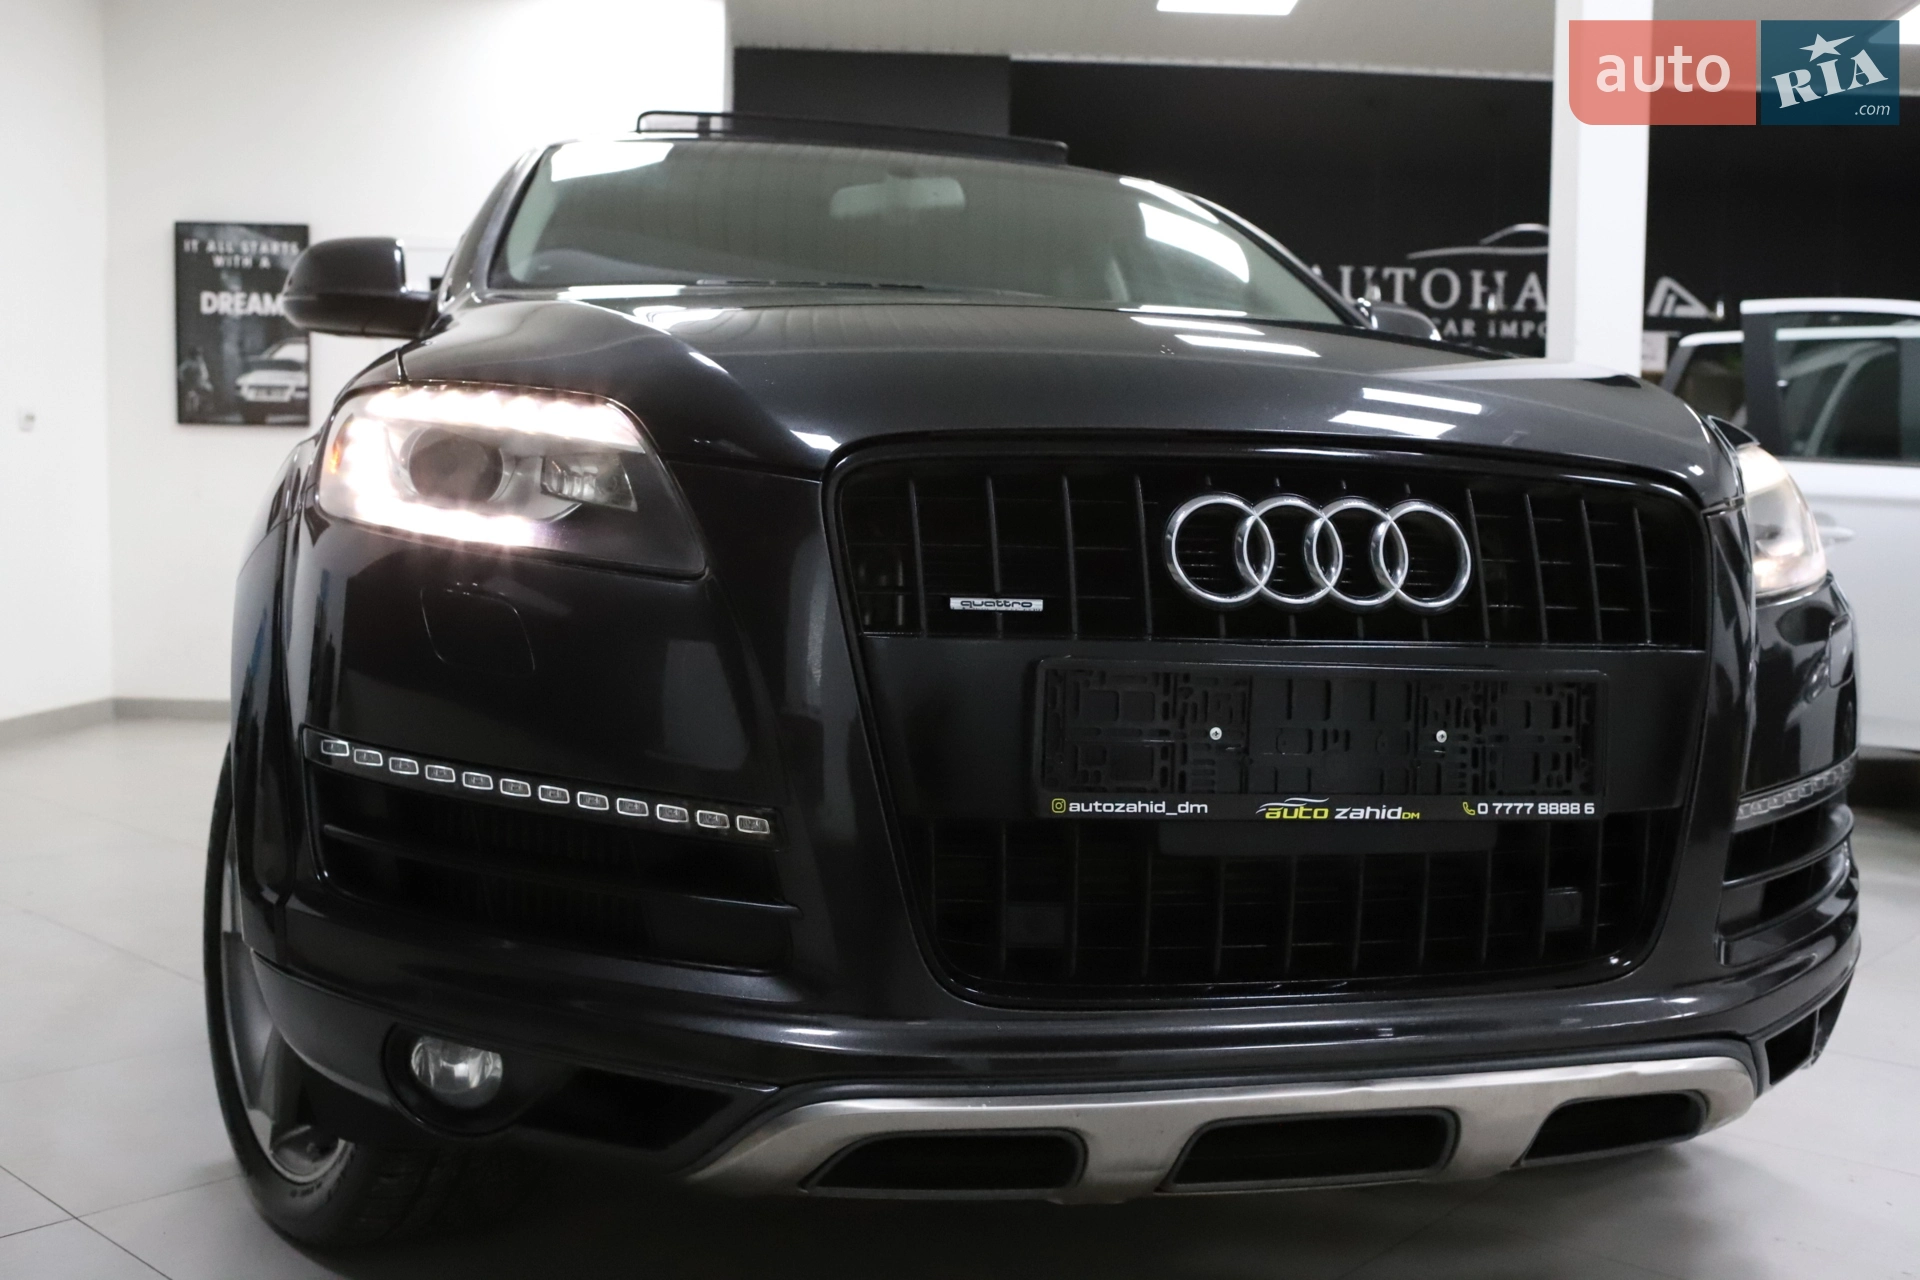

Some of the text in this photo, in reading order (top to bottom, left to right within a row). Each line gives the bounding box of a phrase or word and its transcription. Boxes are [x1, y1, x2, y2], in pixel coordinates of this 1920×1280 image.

[183, 239, 300, 257] IT ALL STARTS
[212, 255, 271, 270] WITH A
[1311, 264, 1548, 313] UTOHA
[960, 600, 1033, 609] quattro
[1068, 800, 1208, 815] autozahid_dm
[1264, 806, 1329, 819] auto
[1492, 803, 1534, 815] 7777
[1538, 803, 1580, 815] 8888
[1584, 803, 1595, 815] 6
